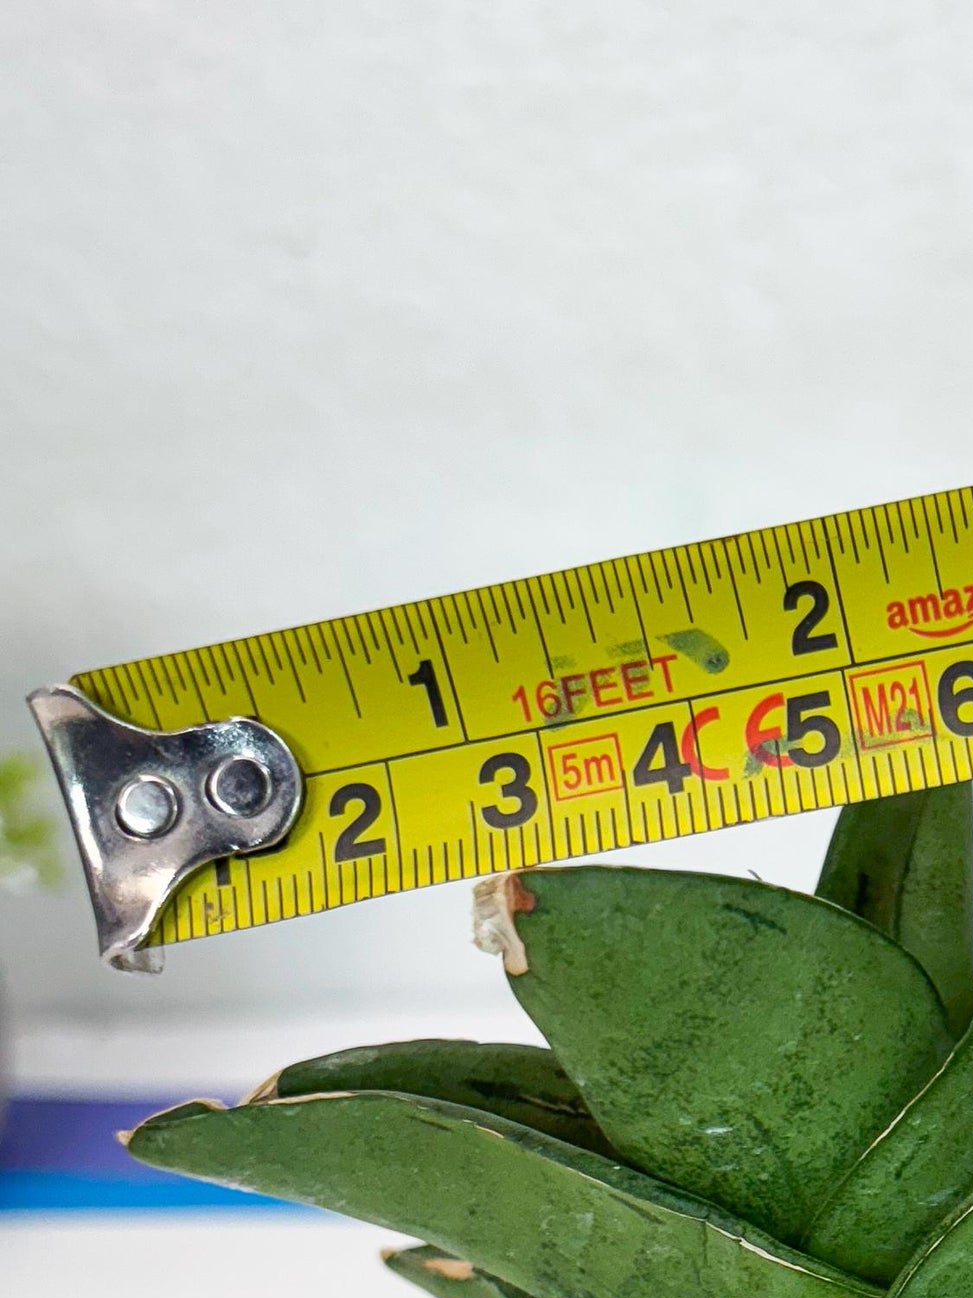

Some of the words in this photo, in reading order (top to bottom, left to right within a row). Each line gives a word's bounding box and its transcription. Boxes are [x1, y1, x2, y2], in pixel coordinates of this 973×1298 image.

[783, 580, 837, 655] 2
[408, 659, 449, 728] 1
[787, 691, 841, 767] 5
[862, 677, 924, 737] M21
[478, 752, 538, 828] 3
[561, 749, 616, 789] 5m
[633, 722, 692, 795] 4
[329, 782, 386, 862] 2
